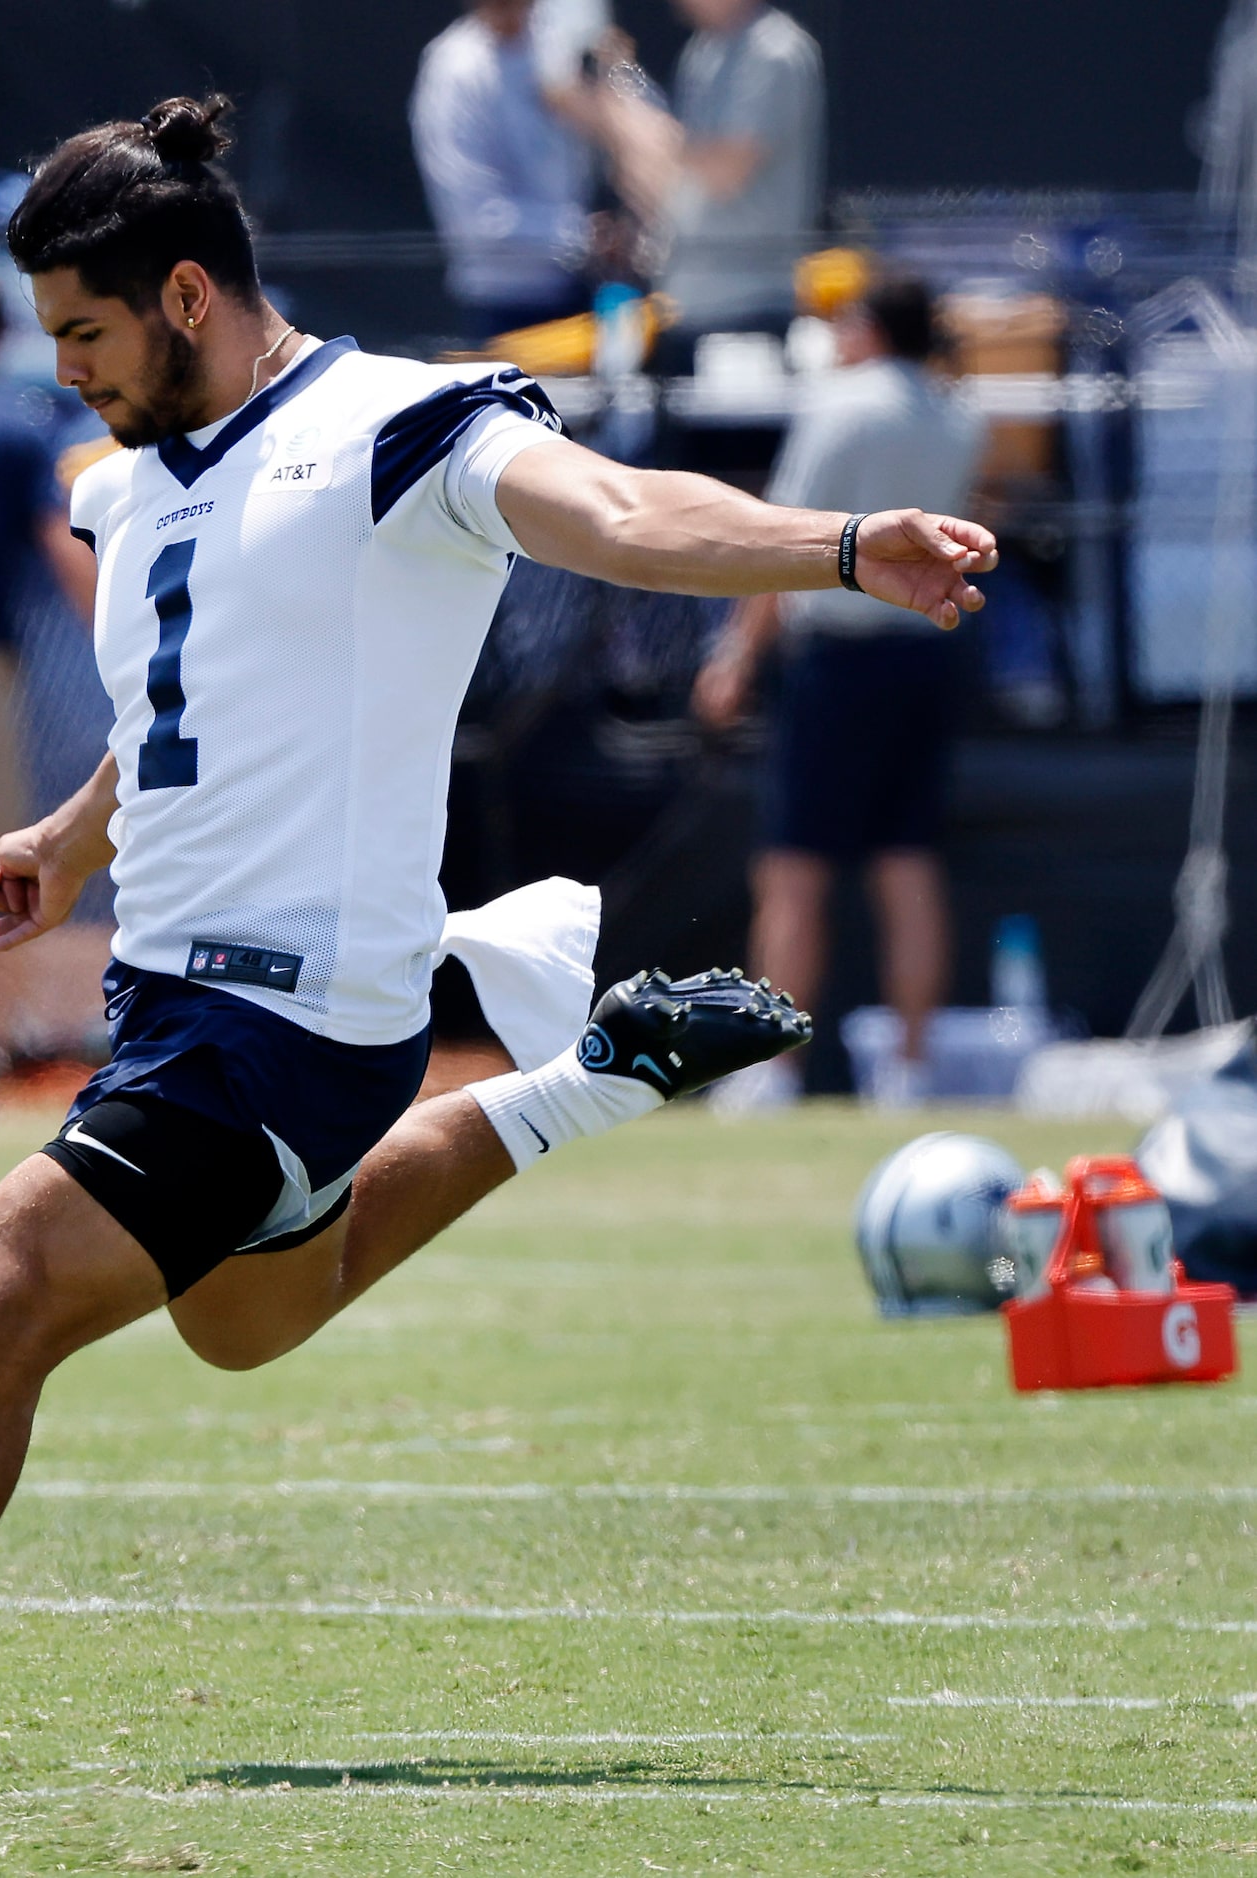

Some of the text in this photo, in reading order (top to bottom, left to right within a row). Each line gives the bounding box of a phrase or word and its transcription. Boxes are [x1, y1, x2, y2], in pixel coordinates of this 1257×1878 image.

[270, 463, 317, 483] AT&T
[155, 500, 215, 531] COWBOYS
[842, 536, 851, 574] PLAYERS
[137, 537, 199, 792] 1
[1160, 1302, 1202, 1368] G
